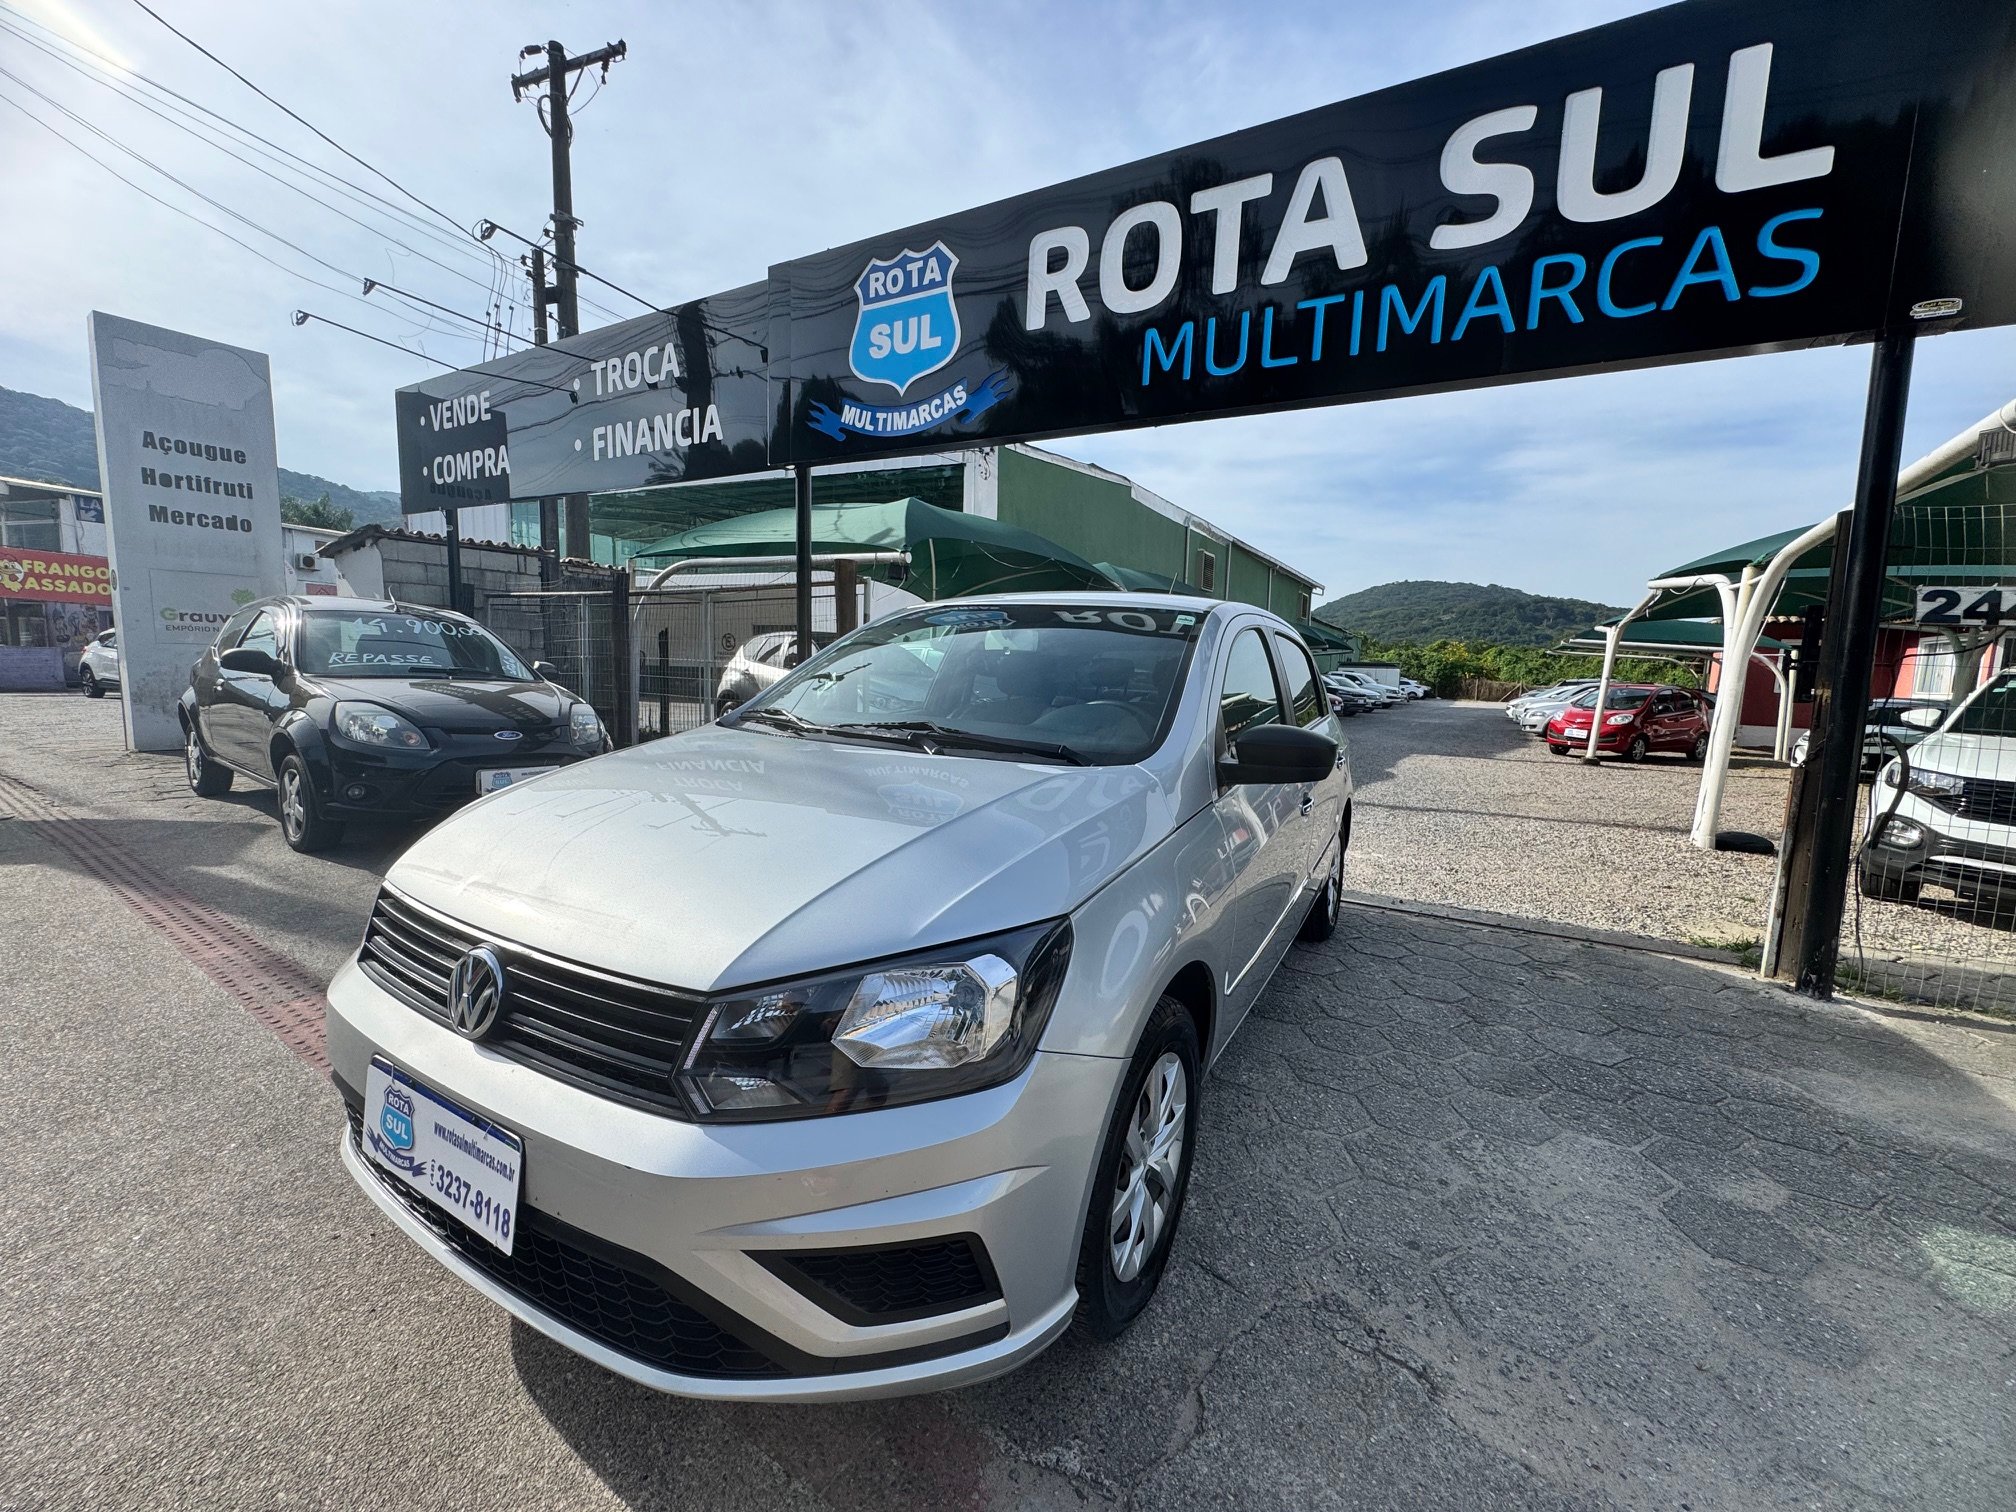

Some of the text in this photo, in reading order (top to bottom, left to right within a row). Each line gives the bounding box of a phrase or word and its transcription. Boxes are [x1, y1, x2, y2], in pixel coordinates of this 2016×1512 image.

[1026, 42, 1835, 331] ROTA SUL
[869, 256, 942, 298] ROTA
[1142, 208, 1824, 386] MULTIMARCAS
[869, 314, 942, 359] SUL
[590, 342, 680, 395] TROCA
[430, 390, 491, 431] VENDE
[841, 385, 967, 431] MULTIMARCAS
[142, 430, 247, 464] Açougue
[592, 404, 723, 461] FINANCIA
[141, 466, 253, 499] Hortifruti
[433, 445, 510, 485] COMPRA
[148, 504, 252, 533] Mercado
[21, 559, 110, 580] FRANGO
[24, 576, 111, 596] ASSADO
[165, 624, 211, 633] EMPÓRIO
[328, 652, 433, 664] REPASSE
[388, 1093, 410, 1115] ROTA
[385, 1113, 408, 1140] SUL
[436, 1164, 511, 1238] 3237-8118
